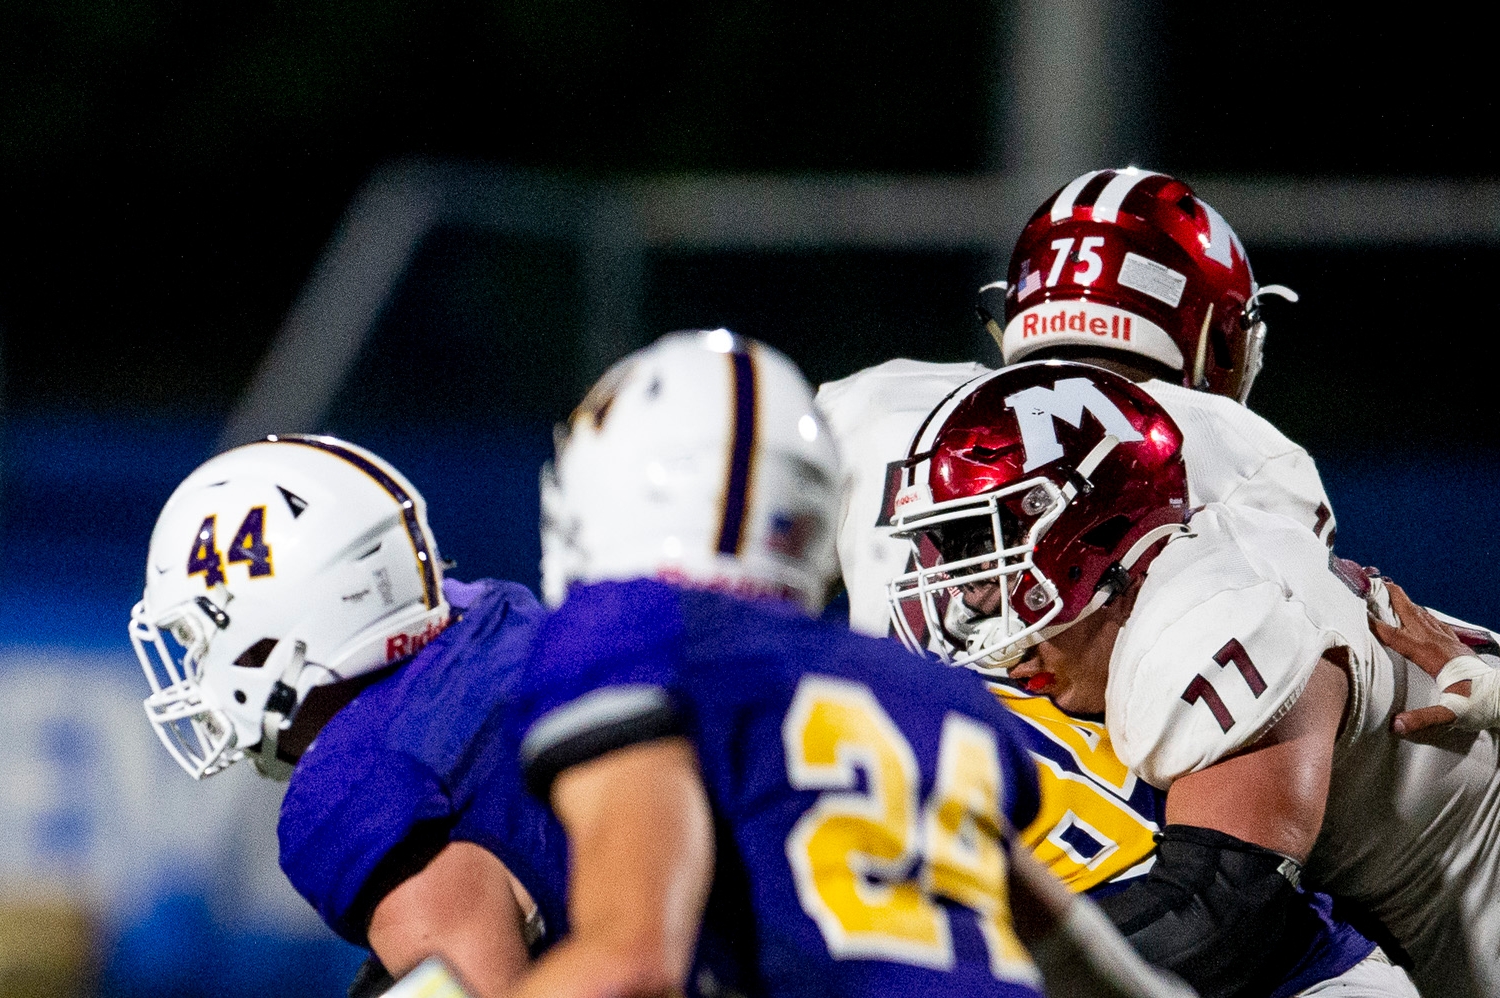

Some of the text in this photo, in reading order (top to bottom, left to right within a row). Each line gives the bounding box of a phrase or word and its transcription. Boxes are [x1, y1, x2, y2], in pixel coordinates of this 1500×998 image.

[1046, 236, 1105, 287] 75
[1022, 312, 1132, 342] Riddell
[1004, 377, 1145, 473] M
[187, 505, 275, 590] 44
[1181, 637, 1268, 734] 77
[783, 674, 1046, 986] 24
